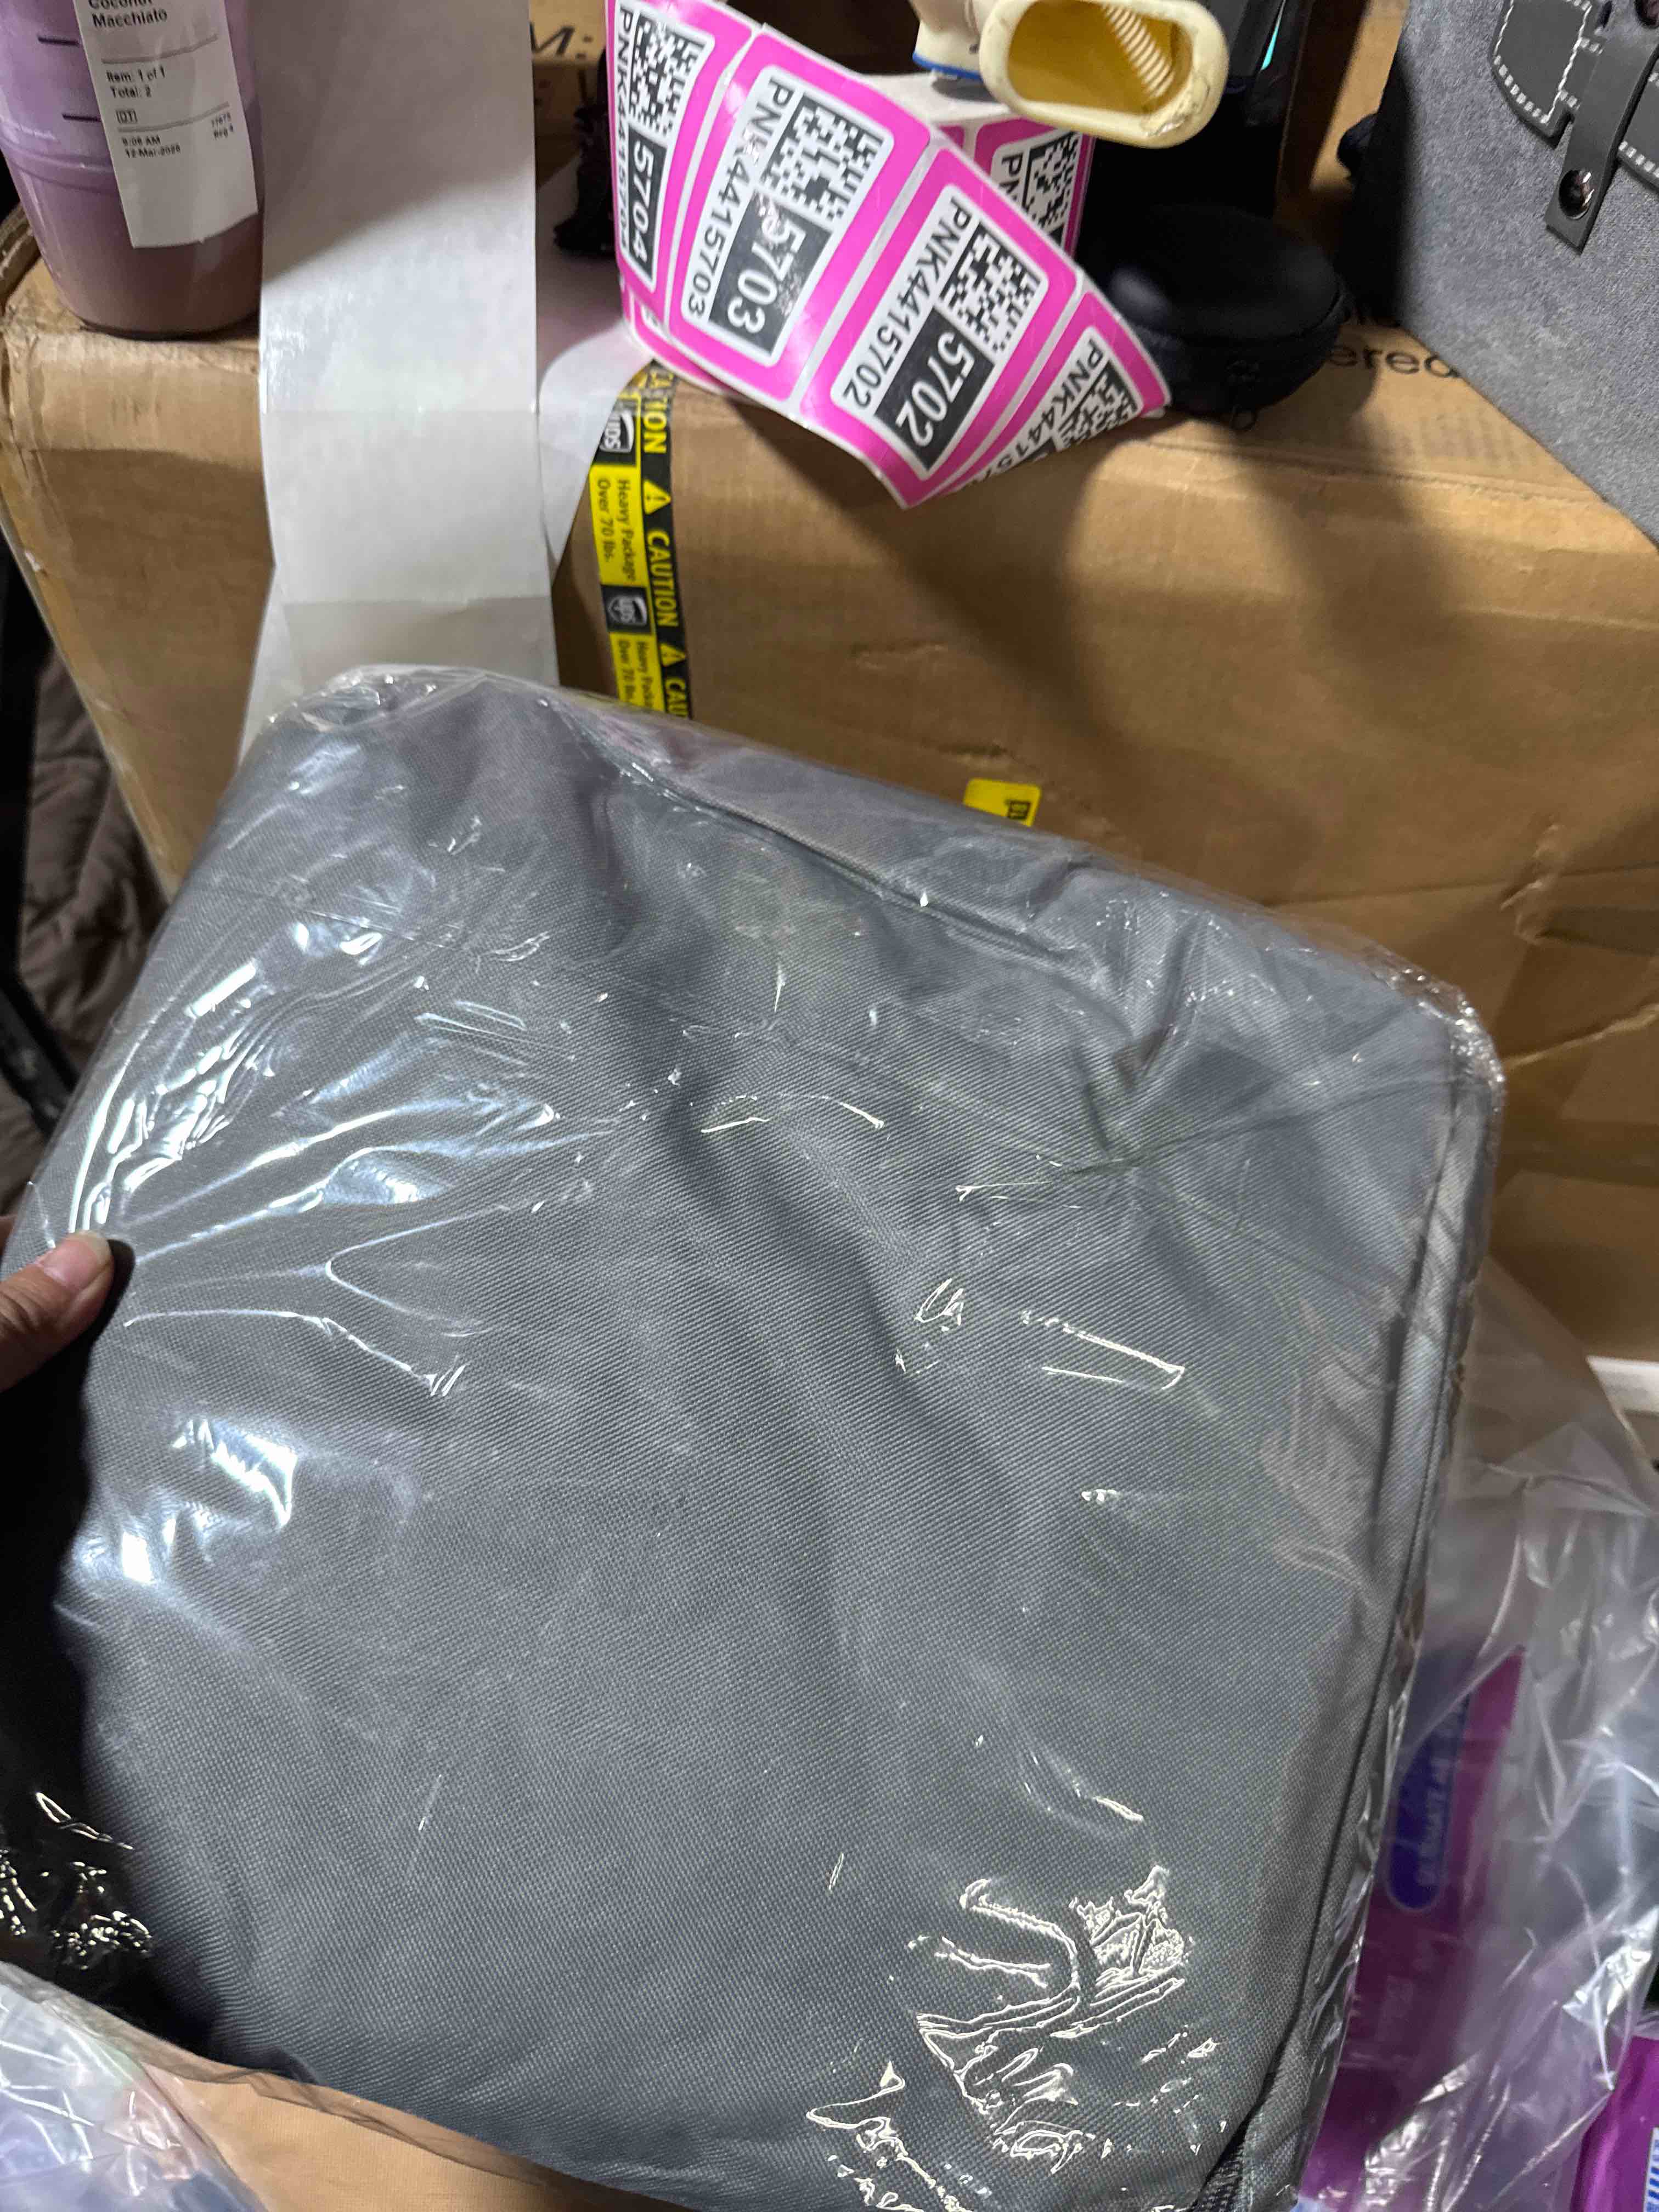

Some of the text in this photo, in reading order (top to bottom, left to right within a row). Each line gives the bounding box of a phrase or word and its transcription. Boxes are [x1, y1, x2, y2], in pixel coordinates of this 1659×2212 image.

[92, 8, 167, 27] Macchiato
[106, 65, 165, 82] Item: 1 of 1
[110, 86, 141, 98] Total:
[145, 134, 161, 145] AM
[632, 140, 656, 264] 5704
[688, 77, 795, 317] PNK4415703
[727, 219, 806, 334] 5703
[843, 196, 972, 408] PNK4415702
[895, 332, 975, 447] 5702
[597, 478, 611, 513] Over
[601, 517, 614, 537] 70
[617, 479, 636, 582] Heavy Package
[647, 531, 679, 627] CAUTION
